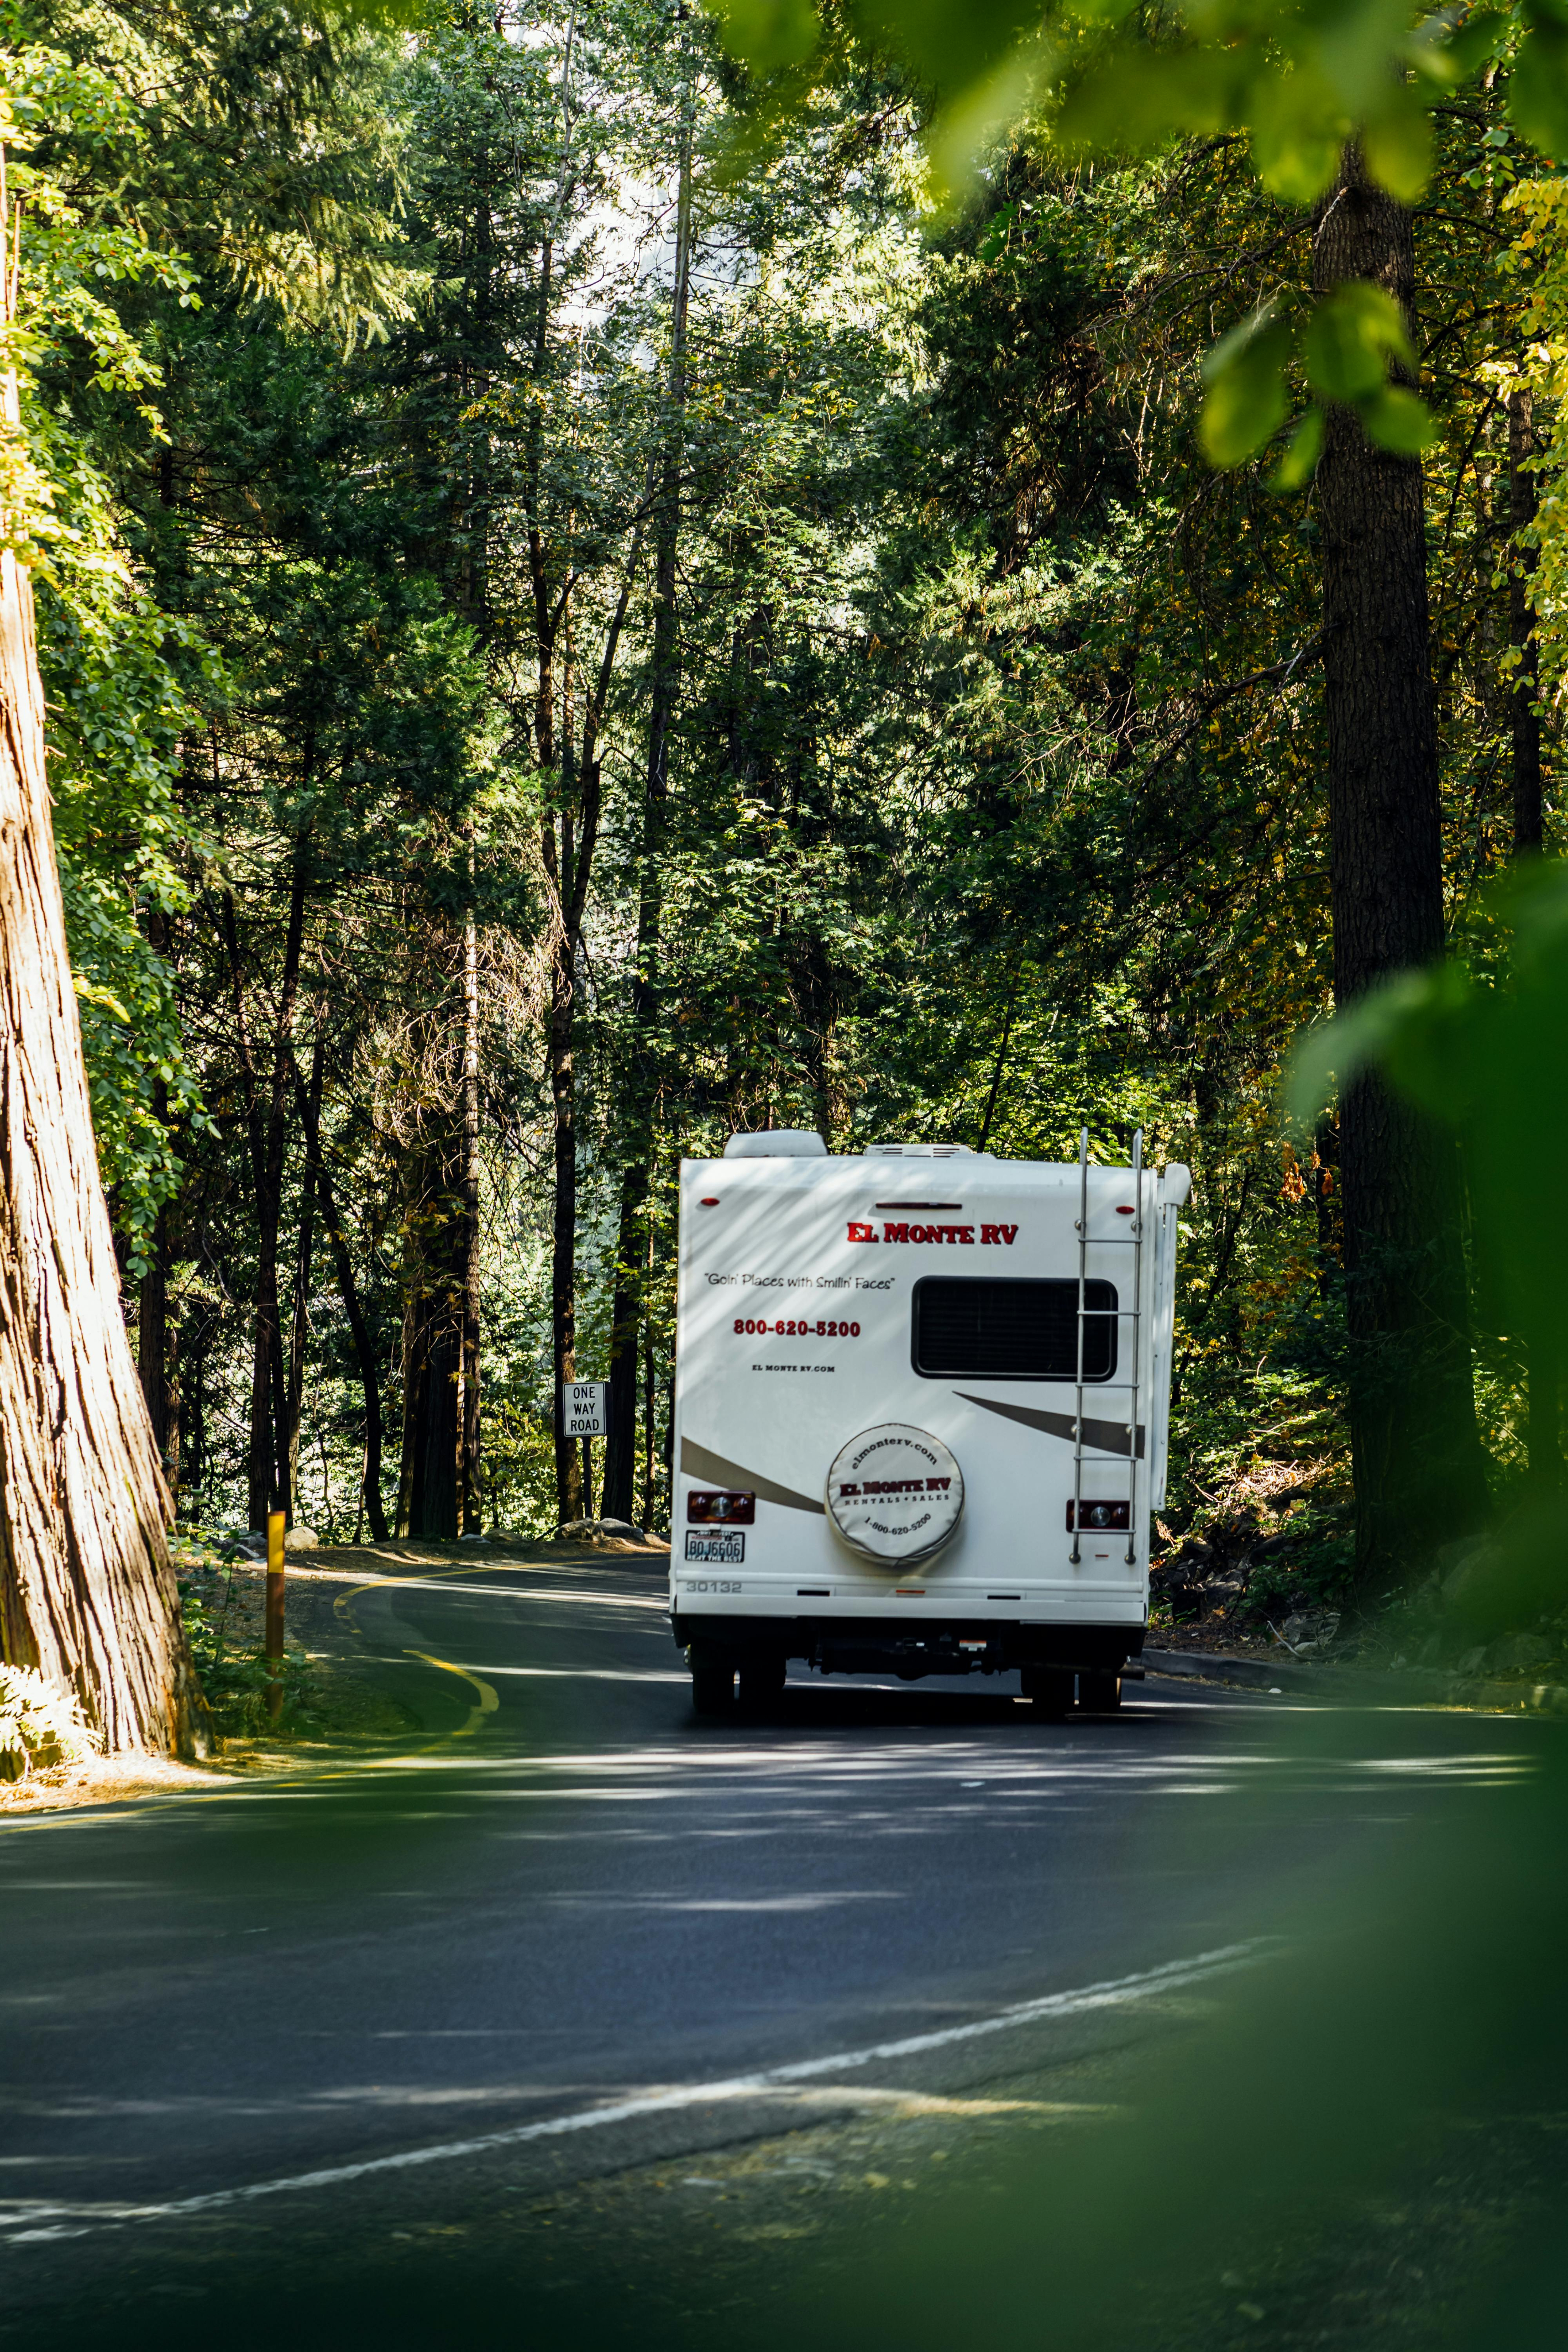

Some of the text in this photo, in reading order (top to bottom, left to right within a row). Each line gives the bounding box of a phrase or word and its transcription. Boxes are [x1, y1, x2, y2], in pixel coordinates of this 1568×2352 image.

[847, 1223, 1019, 1244] EL MONTE RV
[742, 1274, 784, 1287] Places
[788, 1276, 812, 1288] with
[816, 1276, 851, 1289] Smilin'
[855, 1278, 895, 1290] Faces"
[733, 1319, 861, 1337] 800-620-5200
[574, 1387, 595, 1399] ONE
[574, 1403, 595, 1415] WAY
[571, 1419, 599, 1432] ROAD
[852, 1438, 938, 1470] elmonterv.com
[840, 1477, 951, 1497] EL MONTE RV
[845, 1494, 949, 1506] RENTALS SALES
[864, 1513, 931, 1535] 1-800-620-5200
[687, 1581, 742, 1593] 30132
